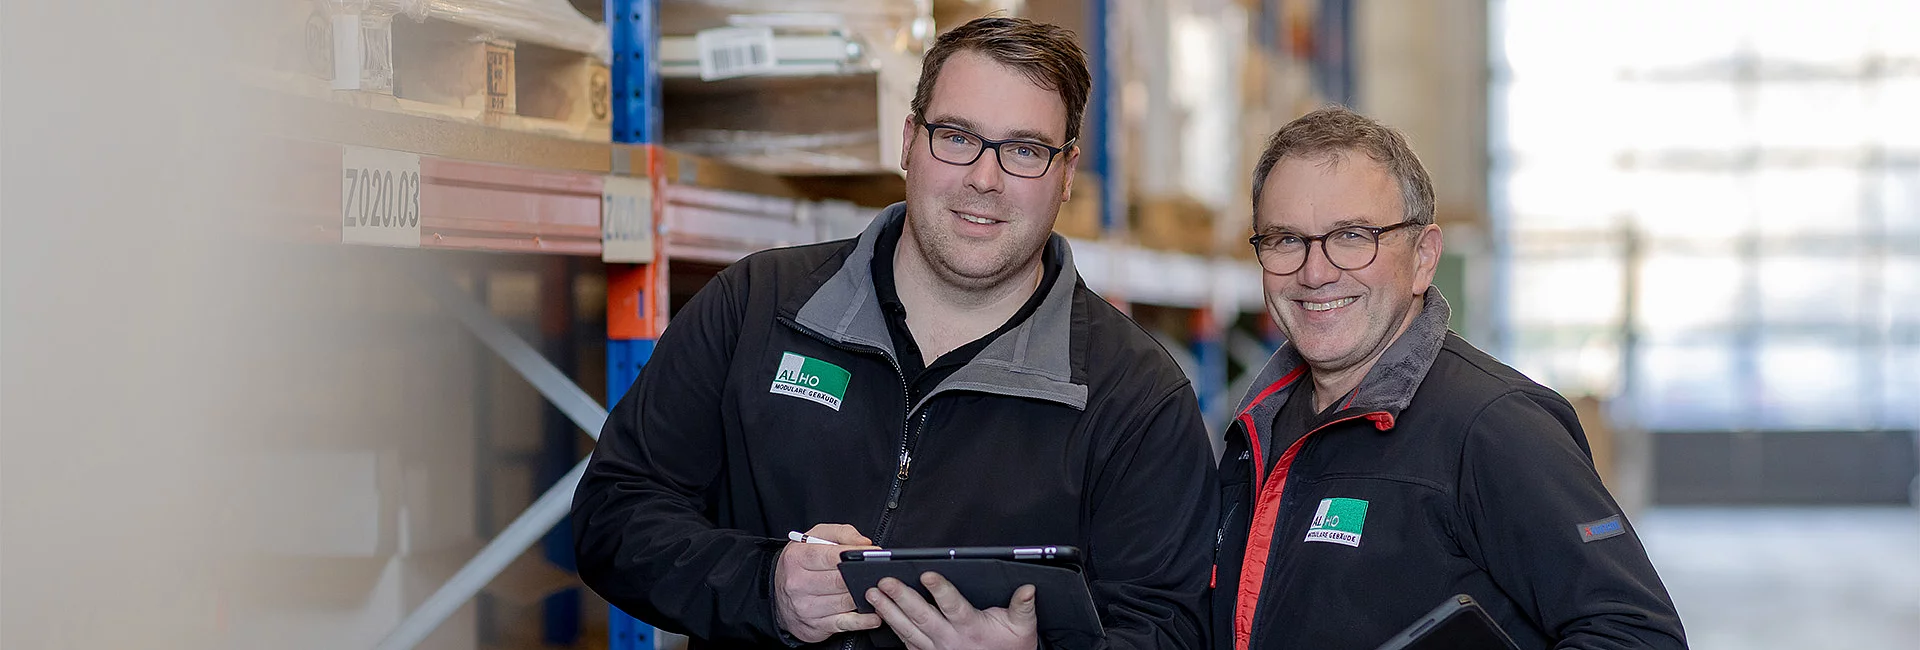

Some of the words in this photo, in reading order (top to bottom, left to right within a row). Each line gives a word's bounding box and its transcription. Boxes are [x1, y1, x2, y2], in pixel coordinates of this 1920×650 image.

[344, 168, 419, 228] Z020.03
[778, 369, 820, 387] ALHO
[774, 383, 807, 396] MODULARE
